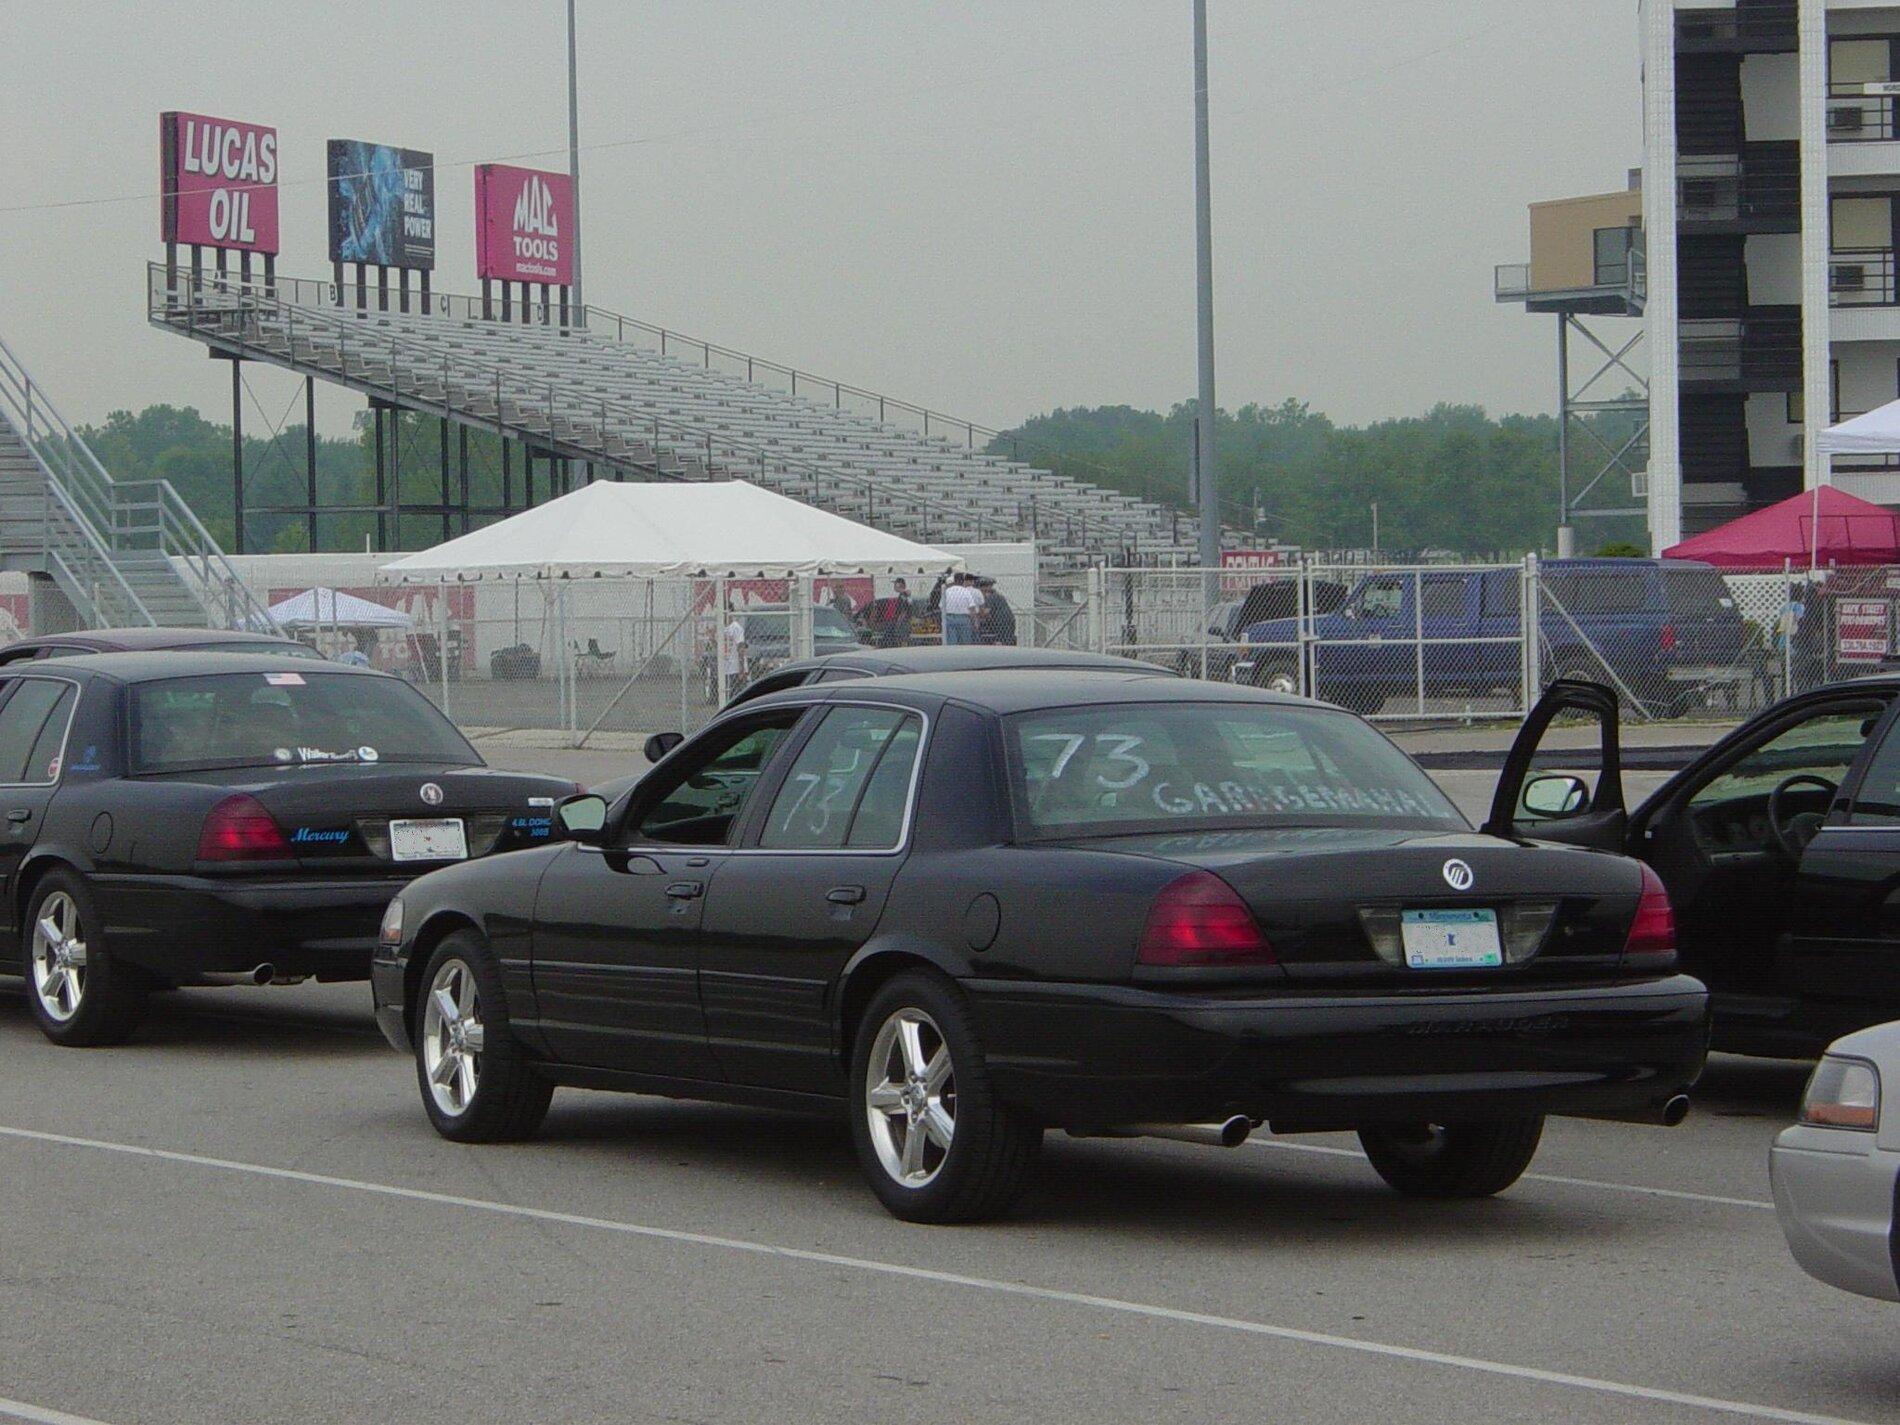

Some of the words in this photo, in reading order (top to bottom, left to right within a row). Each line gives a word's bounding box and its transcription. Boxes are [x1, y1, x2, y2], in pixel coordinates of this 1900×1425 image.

[184, 121, 275, 184] LUCAS
[403, 168, 423, 190] VERY
[209, 187, 254, 243] OIL
[404, 215, 431, 239] POWER
[513, 175, 557, 236] MAC
[513, 236, 558, 261] TOOLS
[1030, 733, 1150, 788] 73
[783, 773, 842, 834] 73
[291, 827, 349, 844] Mercury
